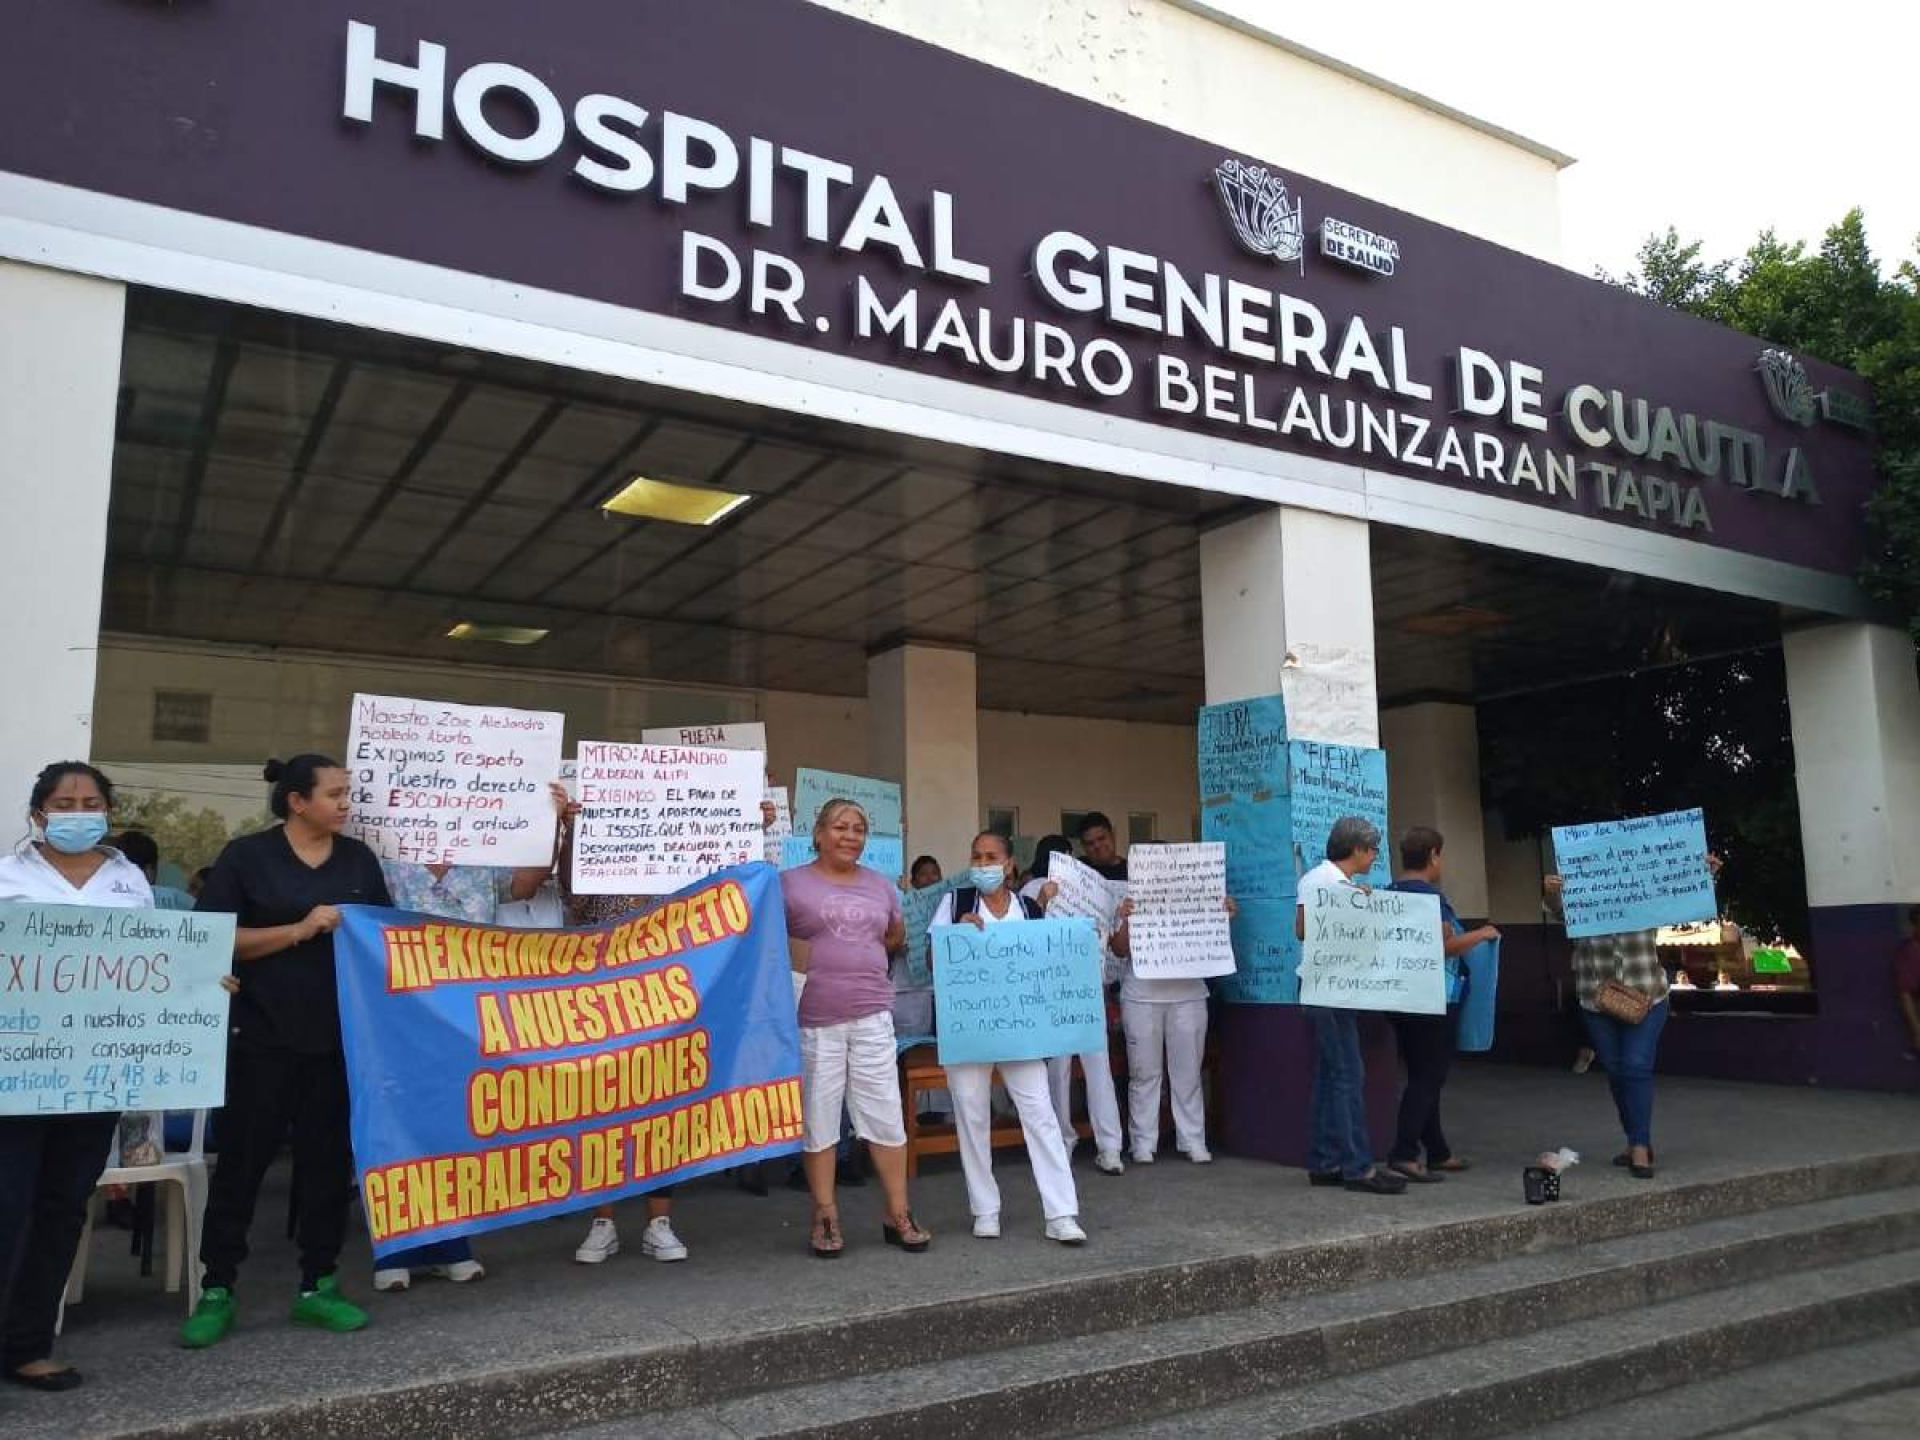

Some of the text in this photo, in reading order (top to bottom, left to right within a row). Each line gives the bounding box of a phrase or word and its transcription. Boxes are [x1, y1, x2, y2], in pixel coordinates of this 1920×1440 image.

[343, 19, 1822, 505] HOSPITAL GENERAL DE CUAUTLA
[1326, 238, 1393, 273] DE SALUD
[682, 230, 1713, 532] DR. MAURO BELAUNZARAN TAPIA
[358, 699, 429, 726] Maestro
[679, 726, 726, 746] FUERA
[355, 741, 524, 773] Exigimos respeto
[640, 748, 728, 766] ALEJANDRO
[358, 769, 537, 793] a nuestro derecho
[580, 767, 645, 781] CALDERON
[653, 768, 690, 782] ALIPI
[350, 786, 374, 804] de
[666, 788, 684, 801] EL
[688, 788, 716, 800] PAGO
[721, 789, 737, 800] DE
[445, 816, 462, 831] al
[581, 807, 742, 820] NUESTRAS APORTACIONES
[354, 826, 380, 844] 47
[414, 831, 438, 848] 48
[449, 832, 472, 848] de
[481, 830, 497, 846] la
[579, 822, 597, 839] AL
[659, 820, 684, 837] QUE
[688, 820, 702, 836] YA
[704, 822, 727, 836] NOS
[724, 840, 734, 851] A
[24, 910, 95, 948] Alejandro
[102, 911, 114, 943] A
[604, 881, 749, 967] RESPETO
[1373, 925, 1434, 944] NUESTRAS
[0, 952, 171, 993] XIGIMOS
[61, 1013, 74, 1029] a
[84, 1004, 147, 1029] nuestros
[156, 1007, 221, 1028] derechos
[479, 966, 698, 1054] A NUESTRAS
[91, 1038, 193, 1063] consagrados
[153, 1066, 170, 1086] de
[180, 1060, 198, 1085] la
[470, 1031, 708, 1136] CONDICIONES
[37, 1088, 142, 1112] LFTSE
[364, 1080, 804, 1240] GENERALES DE TRABAJO!!!
